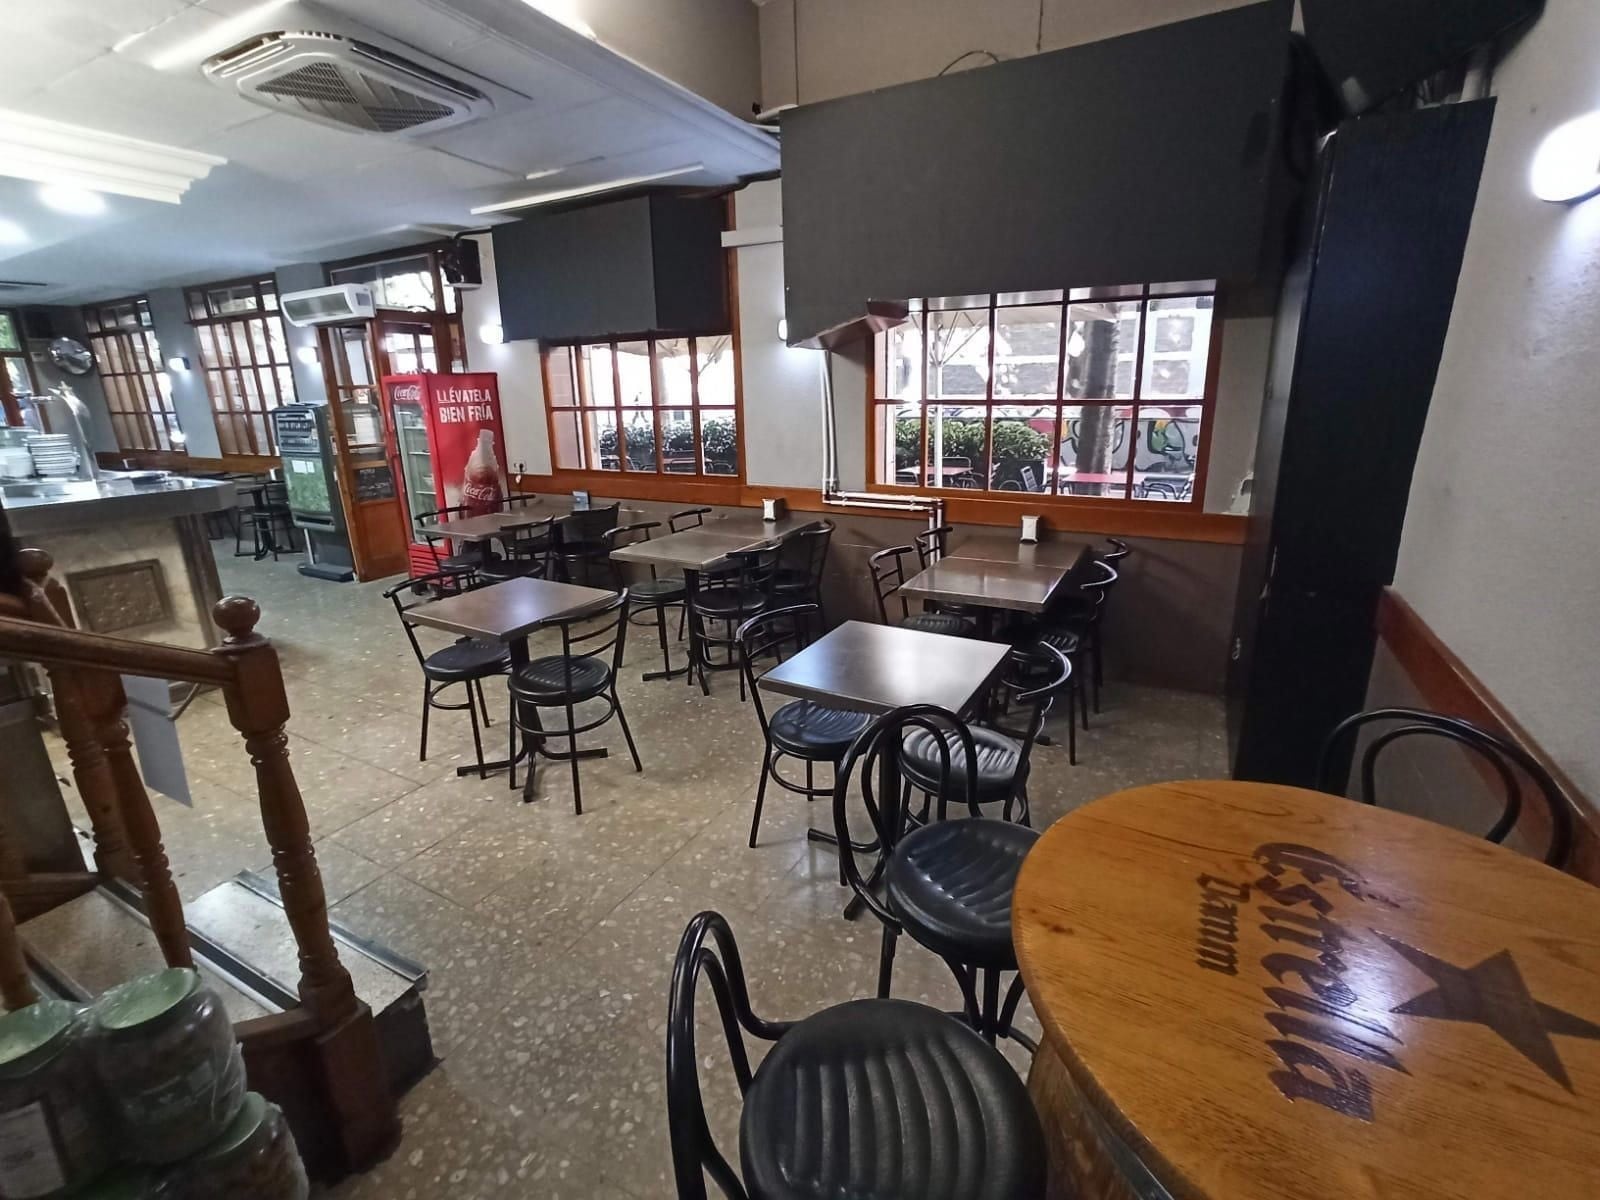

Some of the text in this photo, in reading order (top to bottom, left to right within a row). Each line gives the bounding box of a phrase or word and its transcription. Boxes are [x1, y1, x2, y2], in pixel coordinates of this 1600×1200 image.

[436, 386, 492, 404] LLÉVATELA
[439, 402, 494, 424] BIEN FRÍA
[1196, 872, 1251, 977] Damm
[1253, 842, 1413, 1124] Estrella
